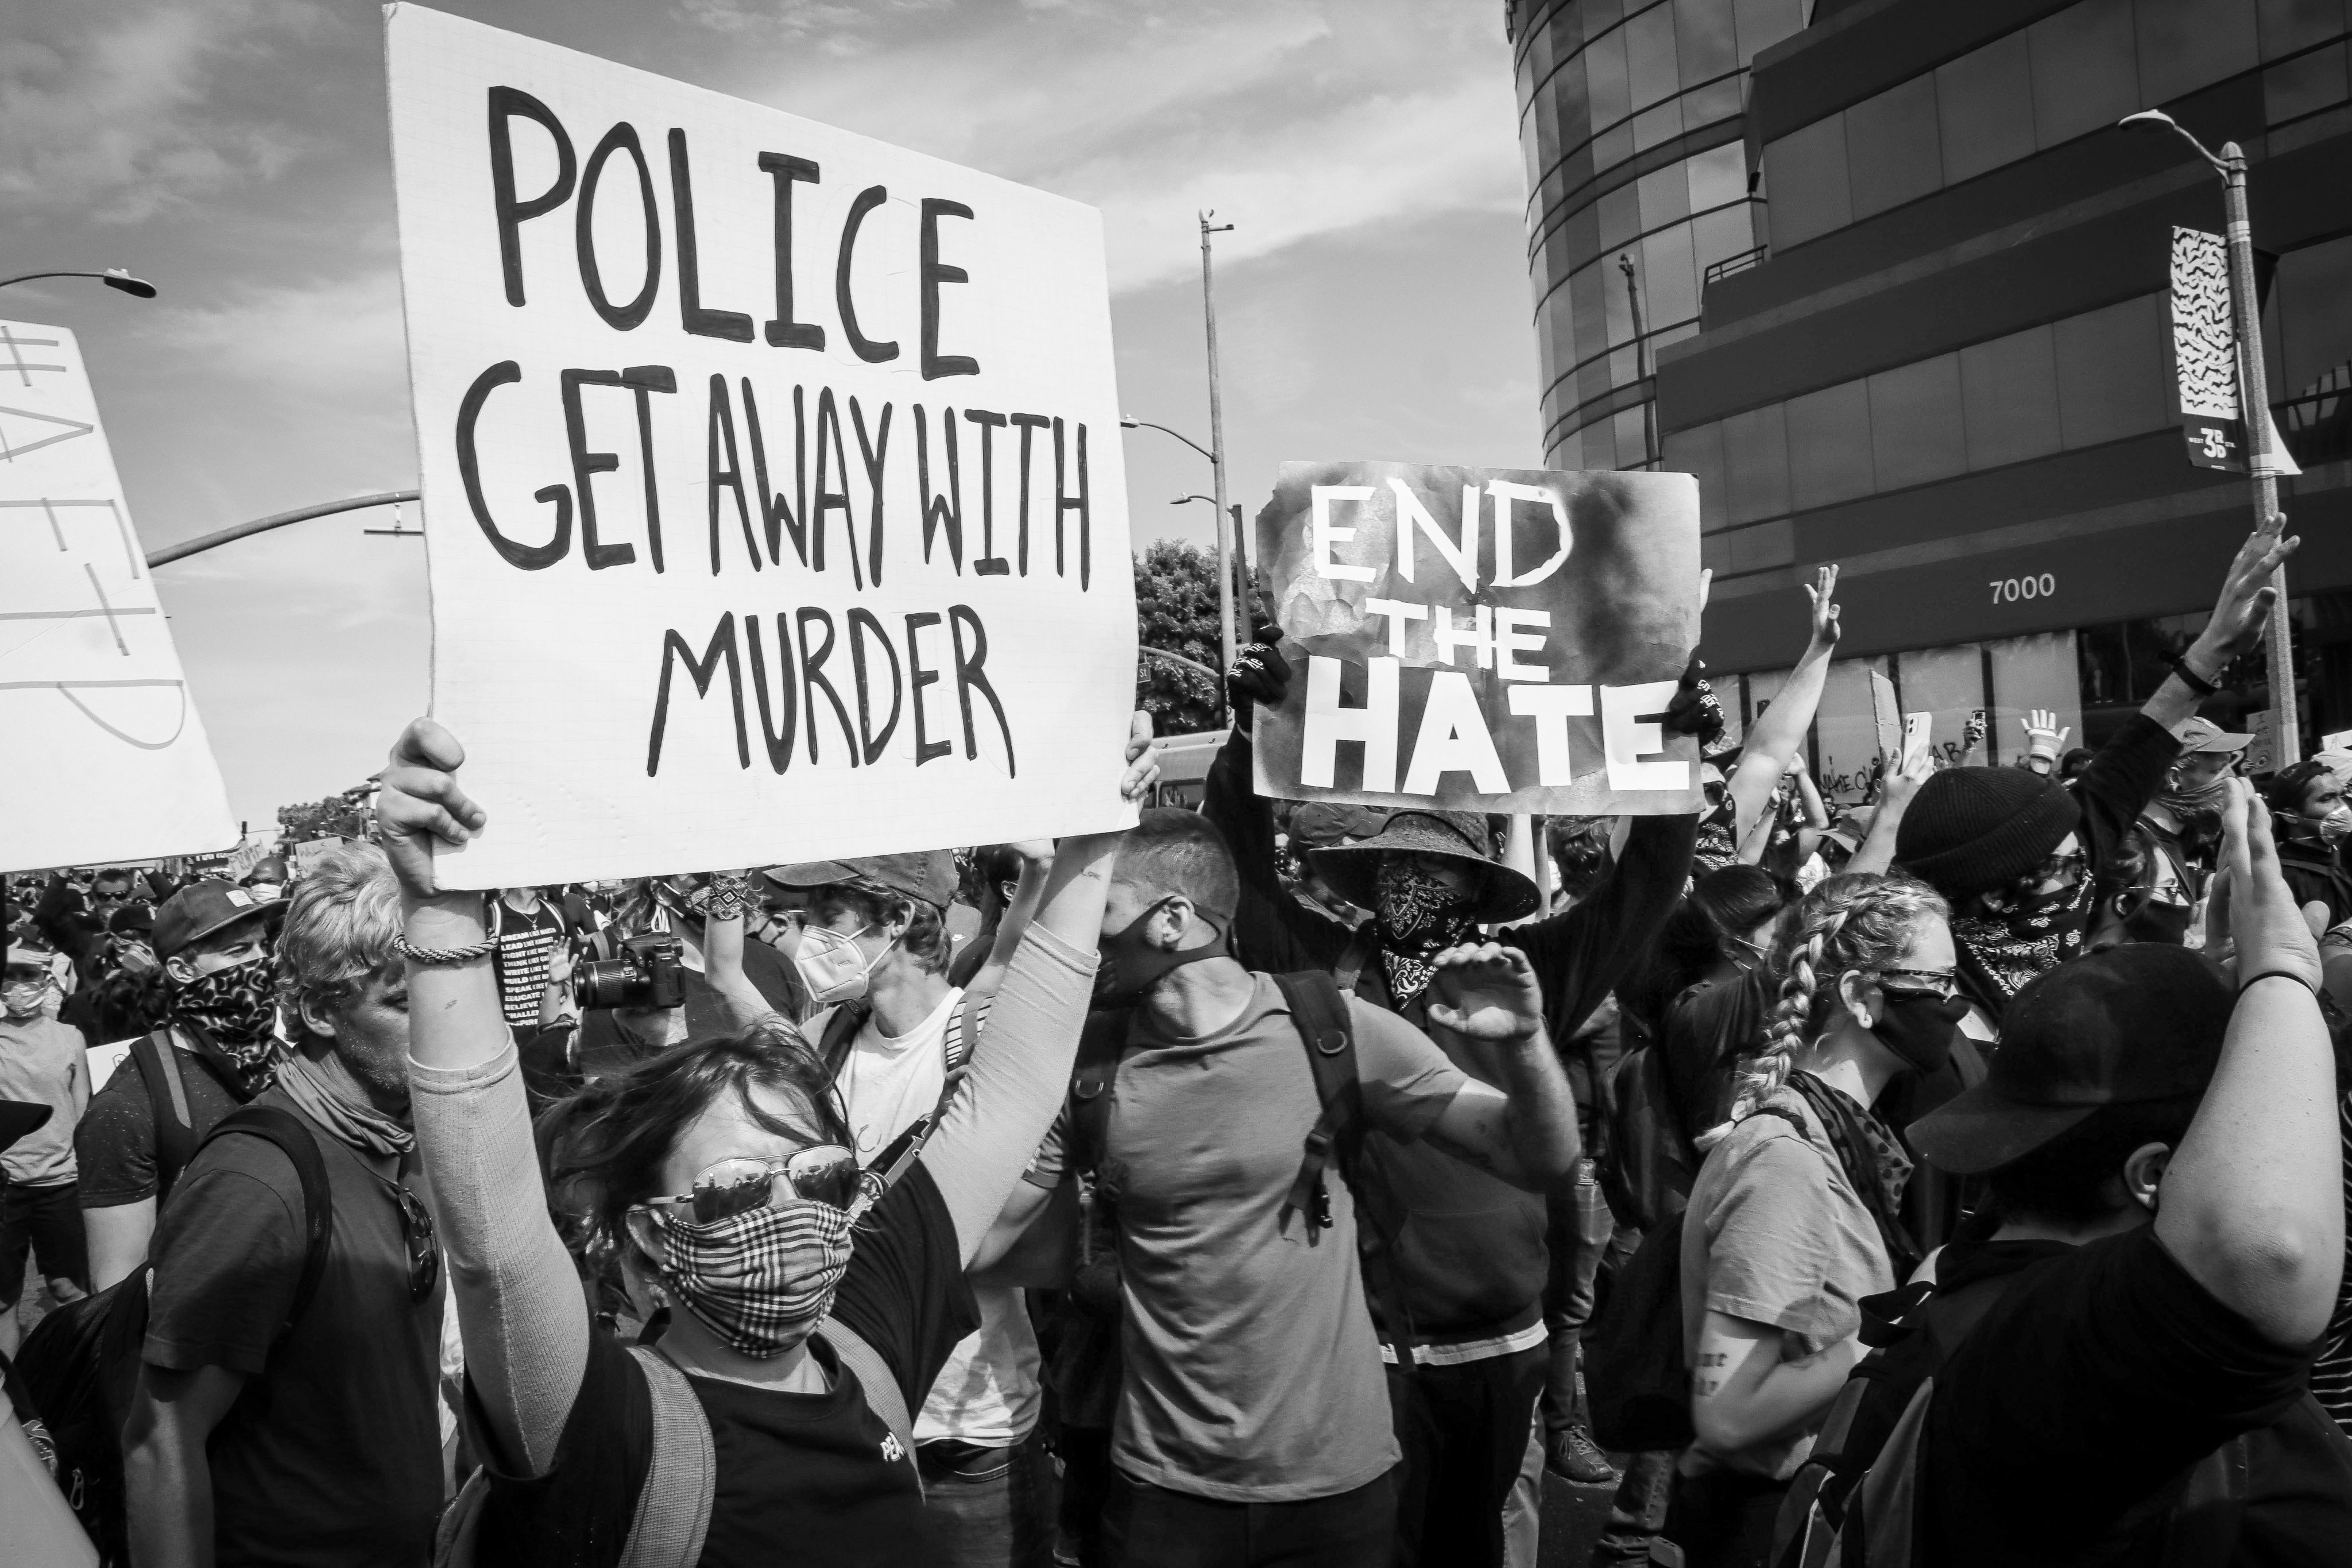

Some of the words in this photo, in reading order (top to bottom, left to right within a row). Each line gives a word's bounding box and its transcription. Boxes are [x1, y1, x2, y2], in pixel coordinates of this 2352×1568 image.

[489, 86, 980, 381] POLICE
[457, 361, 676, 574] GET
[709, 373, 892, 591] AWAY
[913, 404, 1090, 593] WITH
[1310, 472, 1573, 594] END
[1989, 573, 2055, 605] 7000
[1364, 597, 1551, 683] THE
[647, 605, 1015, 779] MURDER
[1301, 656, 1690, 796] HATE
[500, 932, 529, 942] DREAM
[501, 942, 523, 951] LEAD
[502, 951, 526, 959] FIGHT
[504, 959, 528, 967] THINK
[504, 967, 529, 975] WRITE
[505, 985, 532, 993] SPEAK
[505, 992, 540, 1002] EDUCATE
[504, 1001, 539, 1011] BELIEVE
